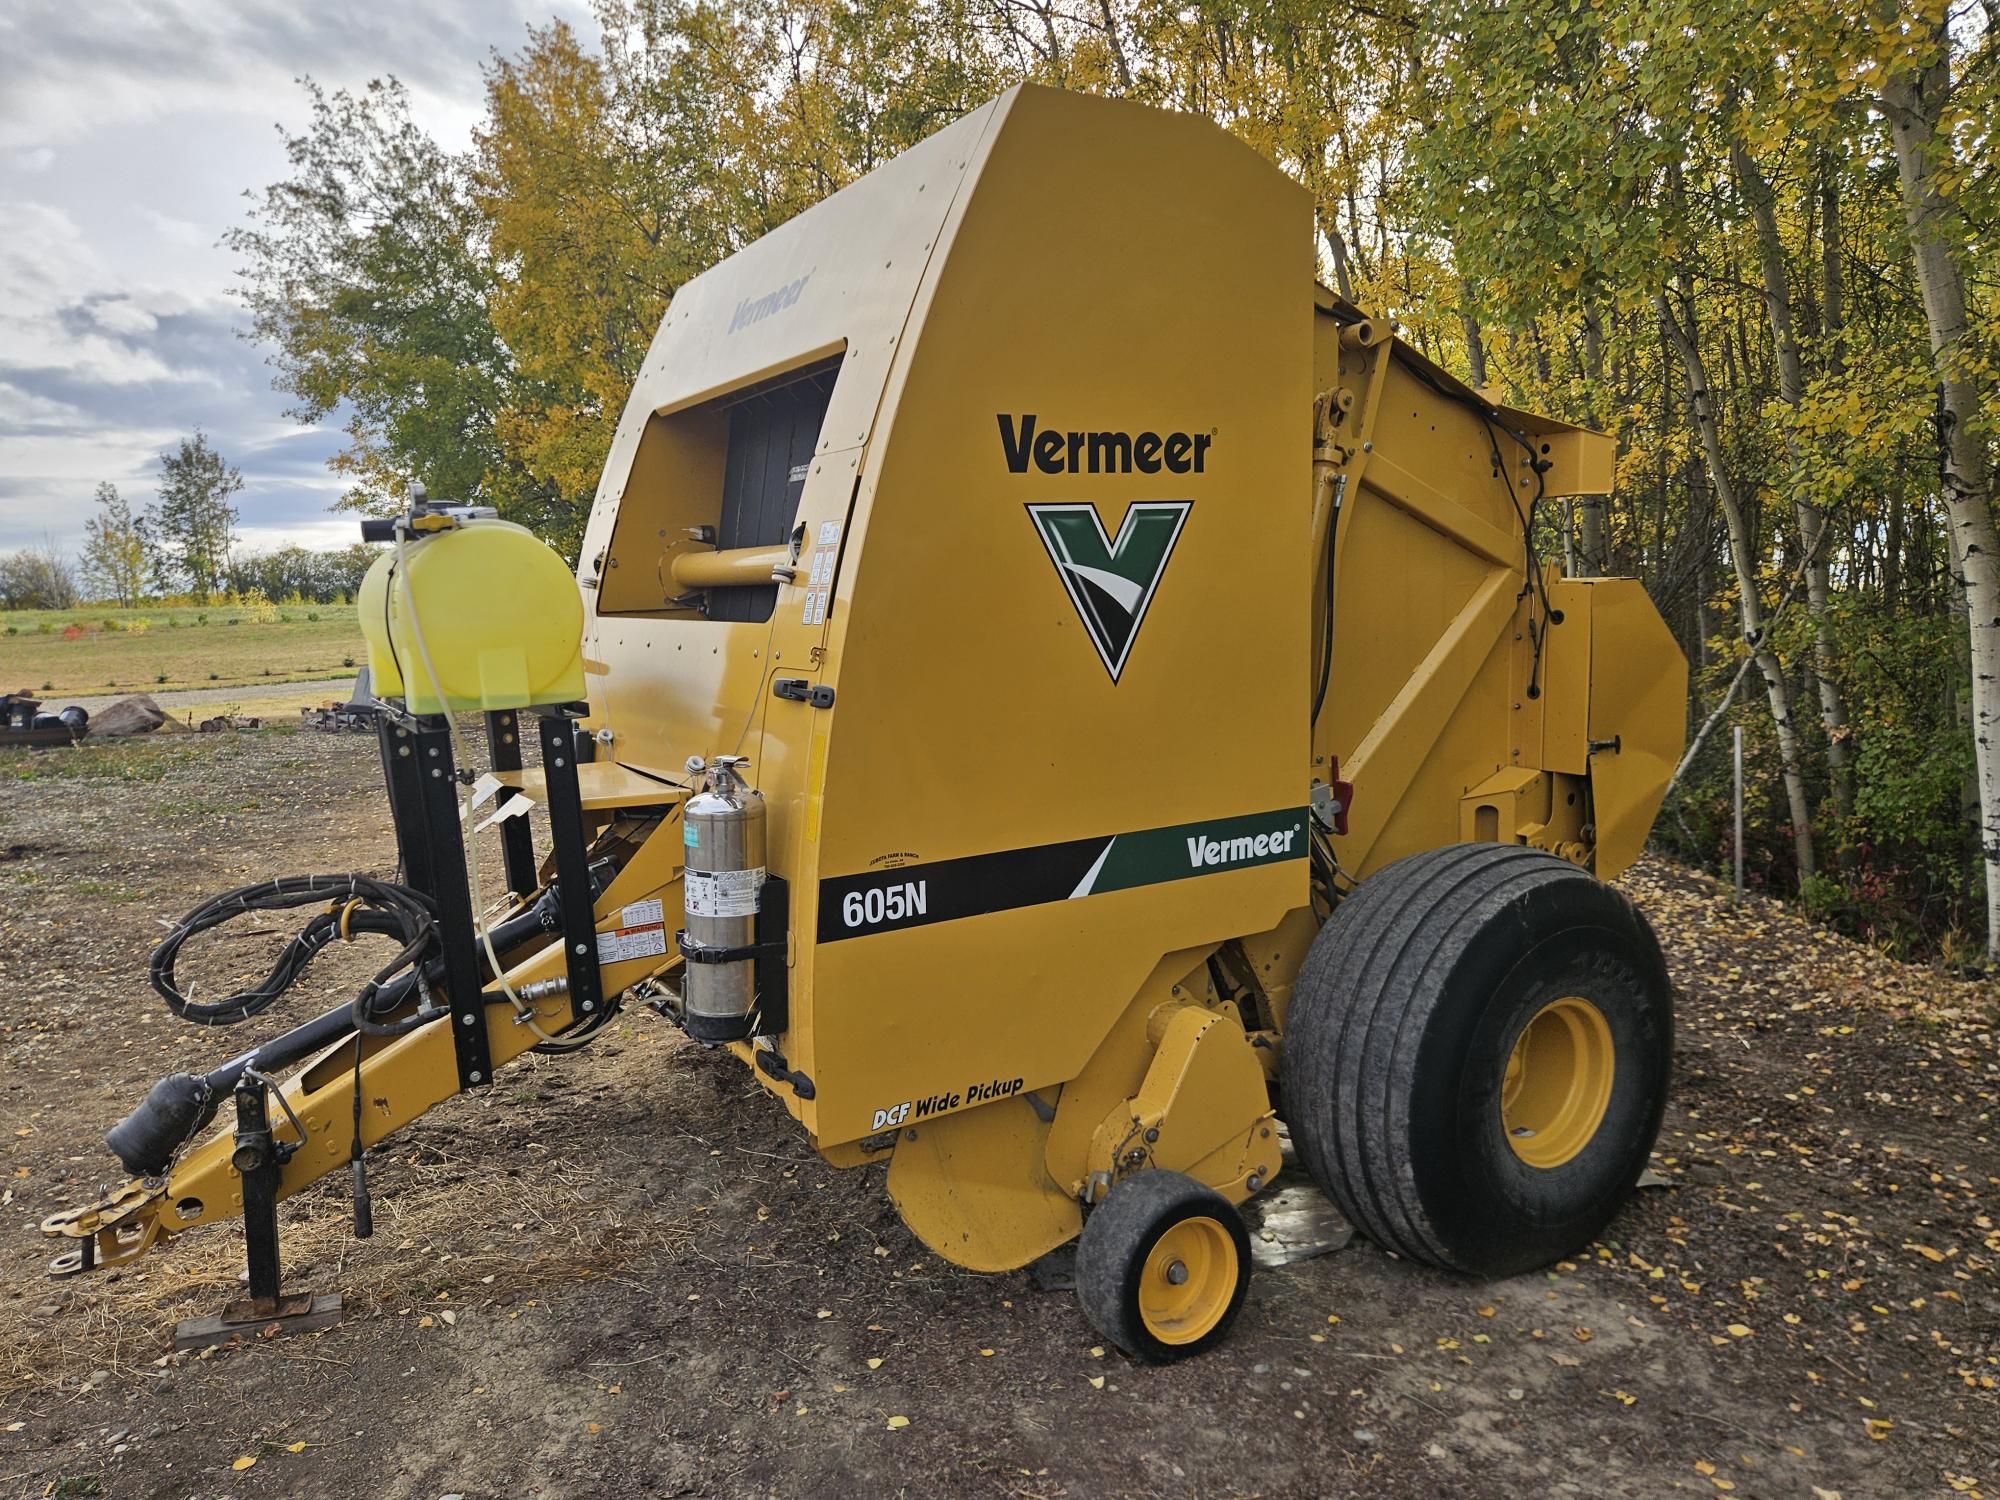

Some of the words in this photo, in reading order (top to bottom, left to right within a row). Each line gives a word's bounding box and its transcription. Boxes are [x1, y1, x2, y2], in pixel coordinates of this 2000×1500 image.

[727, 274, 810, 335] Vermeer
[997, 414, 1212, 474] Vermeer
[1187, 835, 1294, 868] Vermeer
[843, 880, 927, 927] 605N
[631, 924, 661, 935] WARNING
[872, 1101, 911, 1131] DCF
[916, 1092, 960, 1118] Wide
[966, 1078, 1024, 1104] Pickup
